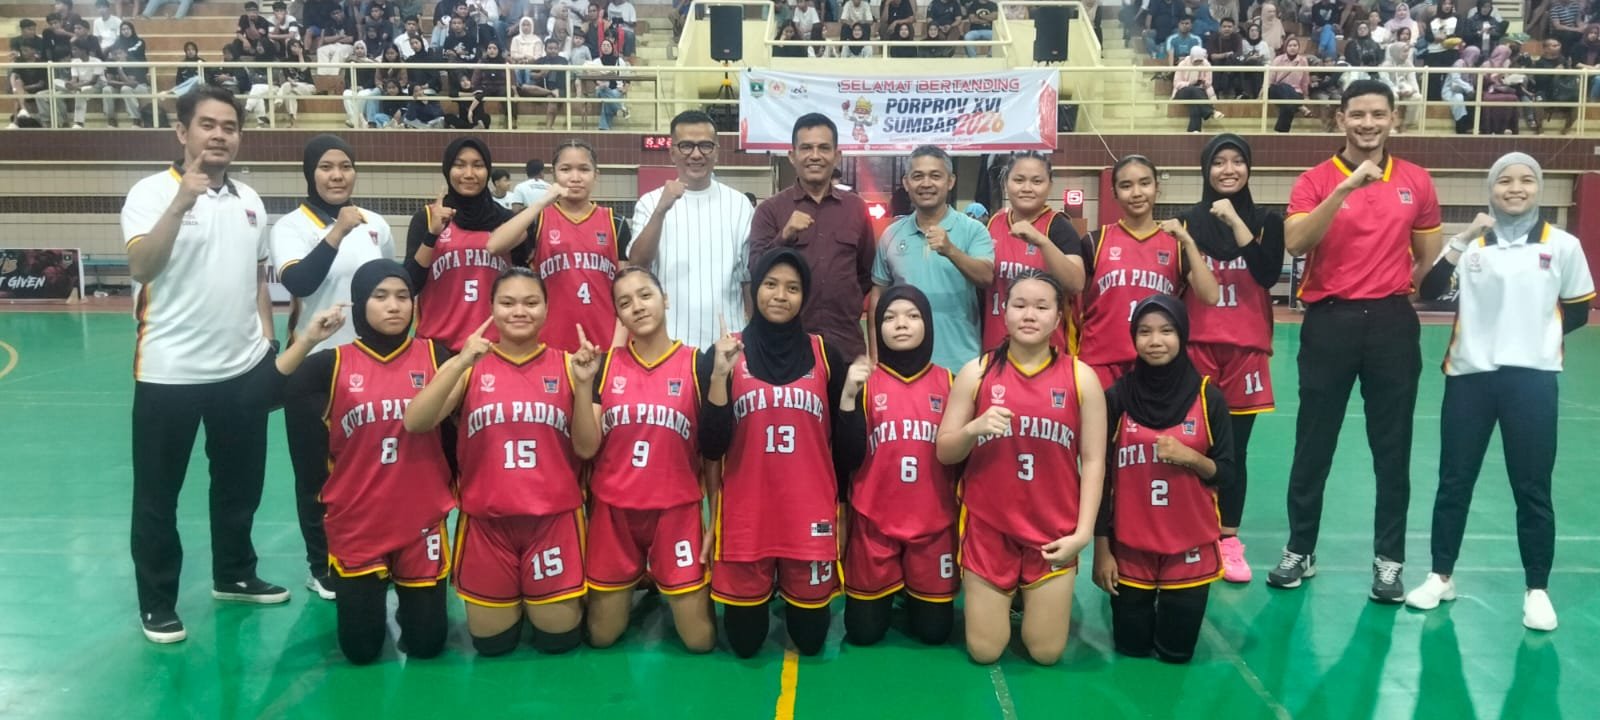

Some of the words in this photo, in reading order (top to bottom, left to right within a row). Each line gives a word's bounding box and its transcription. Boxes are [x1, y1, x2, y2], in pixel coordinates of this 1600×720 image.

[838, 79, 912, 93] SELAMAT
[916, 78, 1020, 93] BERTANDING
[885, 97, 969, 114] PORPROV
[972, 97, 1002, 114] XVI
[882, 116, 958, 134] SUMBAR
[952, 112, 1004, 137] 2026
[432, 250, 461, 280] KOTA
[540, 253, 570, 280] KOTA
[573, 252, 617, 280] PADANG
[8, 275, 46, 290] GIVEN
[464, 279, 478, 302] 5
[577, 282, 591, 304] 4
[1097, 269, 1126, 295] KOTA
[1216, 284, 1237, 306] 11
[1245, 371, 1264, 394] 11
[341, 401, 376, 438] KOTA
[468, 402, 505, 438] KOTA
[512, 401, 570, 438] PADAN
[602, 404, 630, 436] KOTA
[637, 403, 691, 440] PADANG
[1019, 415, 1074, 450] PADANG
[381, 438, 398, 464] 8
[765, 425, 795, 453] 13
[504, 440, 536, 469] 15
[632, 440, 650, 468] 9
[1018, 454, 1034, 481] 3
[901, 456, 917, 482] 6
[1151, 479, 1168, 506] 2
[426, 534, 440, 561] 8
[675, 540, 694, 567] 9
[531, 546, 564, 580] 15
[810, 560, 832, 585] 13
[940, 553, 953, 579] 6
